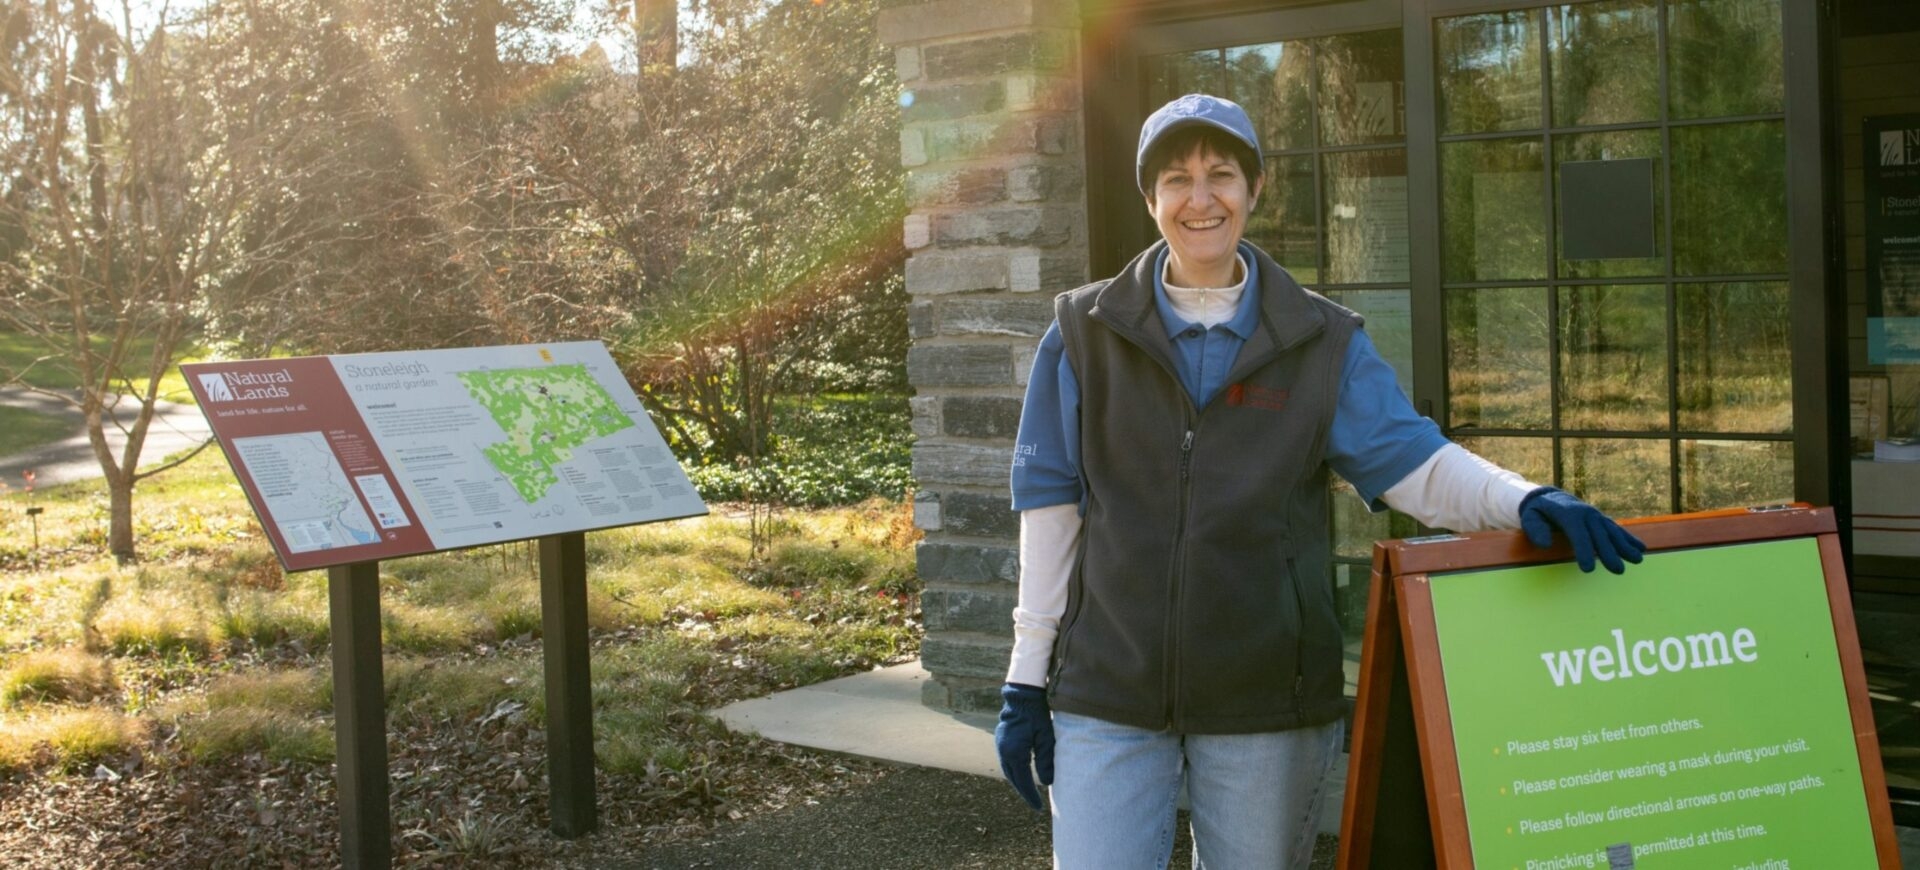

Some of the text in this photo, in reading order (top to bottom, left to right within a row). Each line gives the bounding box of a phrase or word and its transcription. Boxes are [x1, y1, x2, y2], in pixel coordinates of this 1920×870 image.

[223, 368, 294, 386] Natural
[344, 359, 430, 379] Stoneleigh
[230, 384, 290, 401] Lands
[355, 378, 439, 392] a natural garden
[234, 408, 246, 416] for
[1540, 627, 1758, 687] welcome
[1507, 718, 1704, 756] Please stay six feet from others.
[1513, 738, 1810, 795] Please consider wearing a mask during your visit.
[1519, 774, 1825, 835] Please follow directional arrows on one-way paths.
[1526, 823, 1768, 870] Picnicking is permitted at this time.
